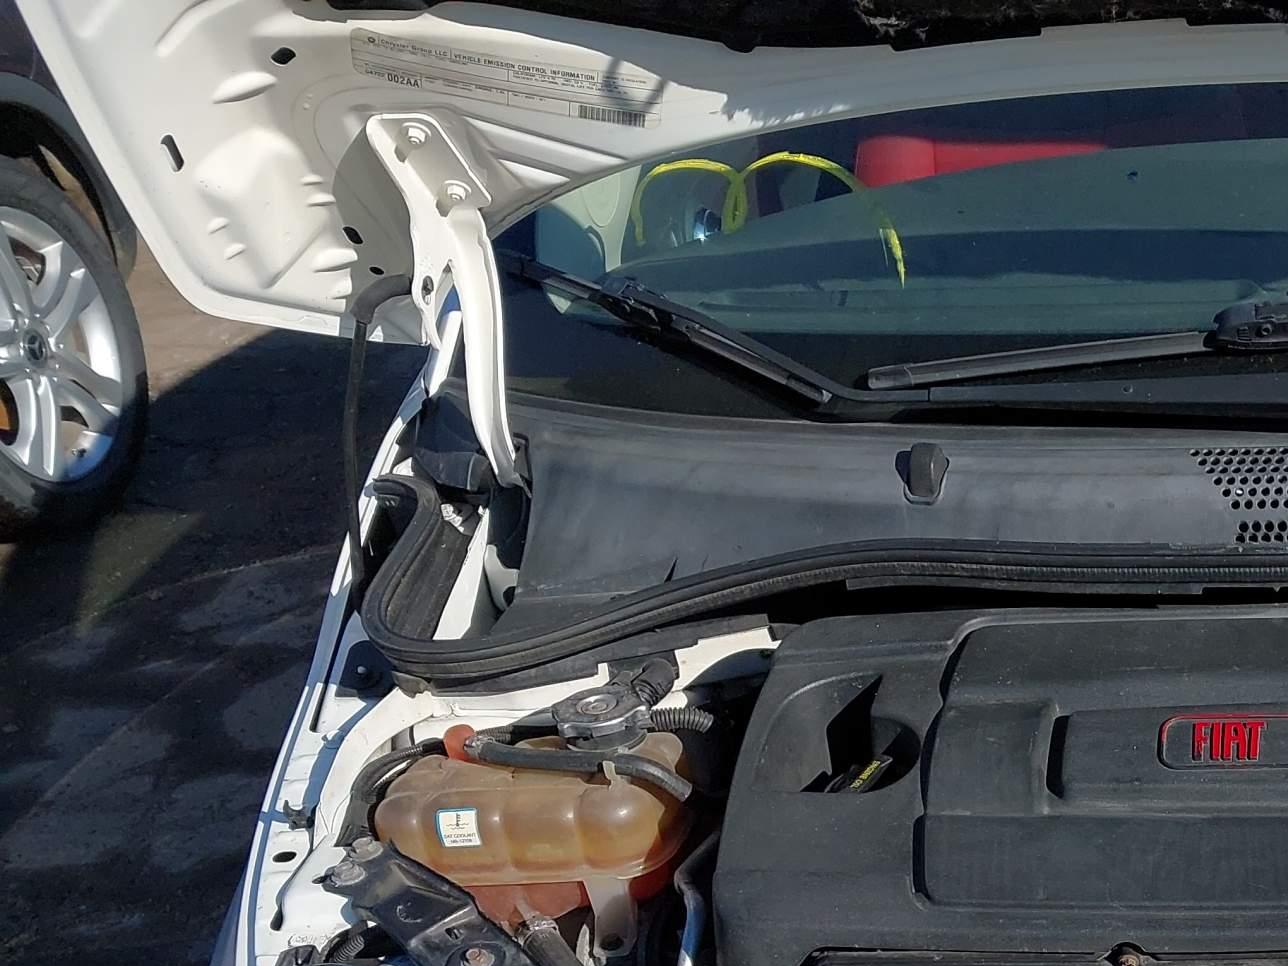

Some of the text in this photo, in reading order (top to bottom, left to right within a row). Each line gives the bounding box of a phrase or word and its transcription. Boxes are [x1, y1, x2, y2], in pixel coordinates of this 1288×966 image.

[434, 49, 449, 58] LLC
[453, 53, 481, 64] VEHICLE
[483, 58, 516, 69] EMISSION
[517, 63, 548, 75] CONTROL
[550, 68, 596, 82] INFORMATION
[1190, 719, 1267, 763] FIAT
